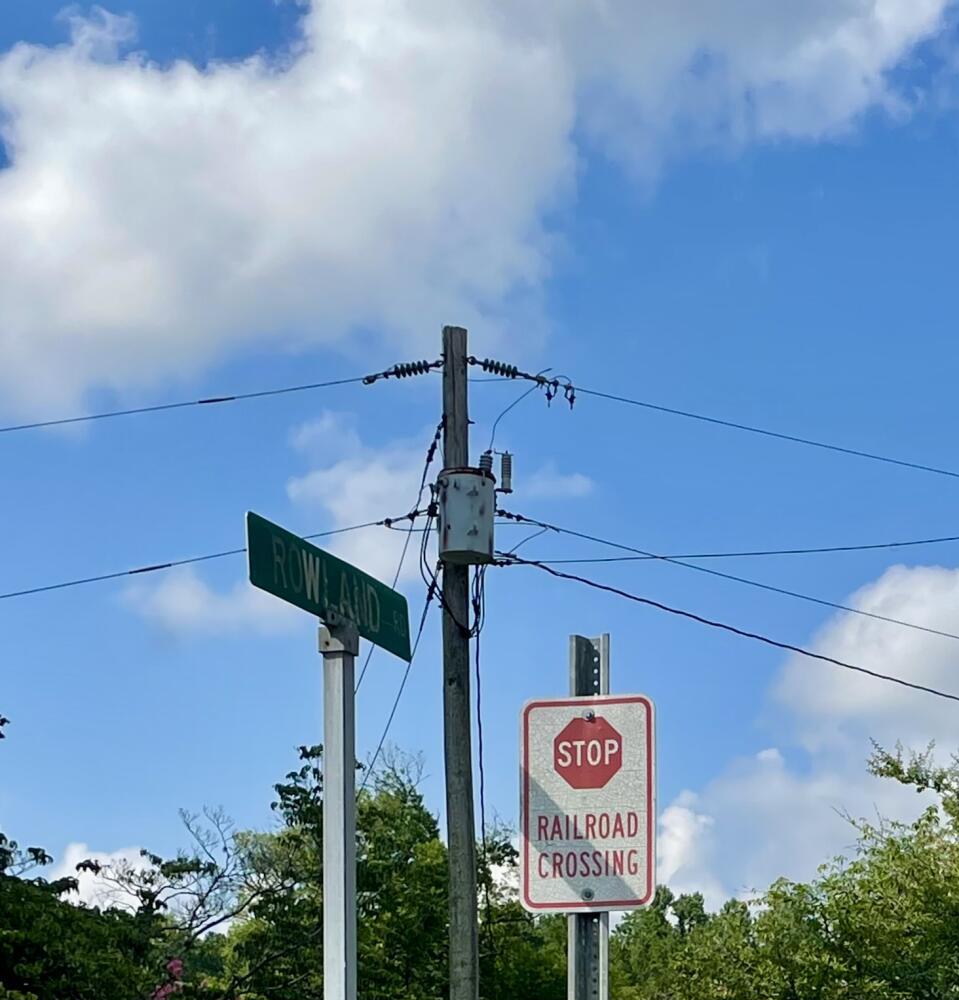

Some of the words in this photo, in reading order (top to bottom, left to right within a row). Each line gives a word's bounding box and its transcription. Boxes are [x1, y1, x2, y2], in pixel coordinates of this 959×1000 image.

[272, 535, 380, 633] ROWLAND
[558, 739, 619, 767] STOP
[538, 812, 639, 841] RAILROAD
[538, 850, 639, 878] CROSSING
